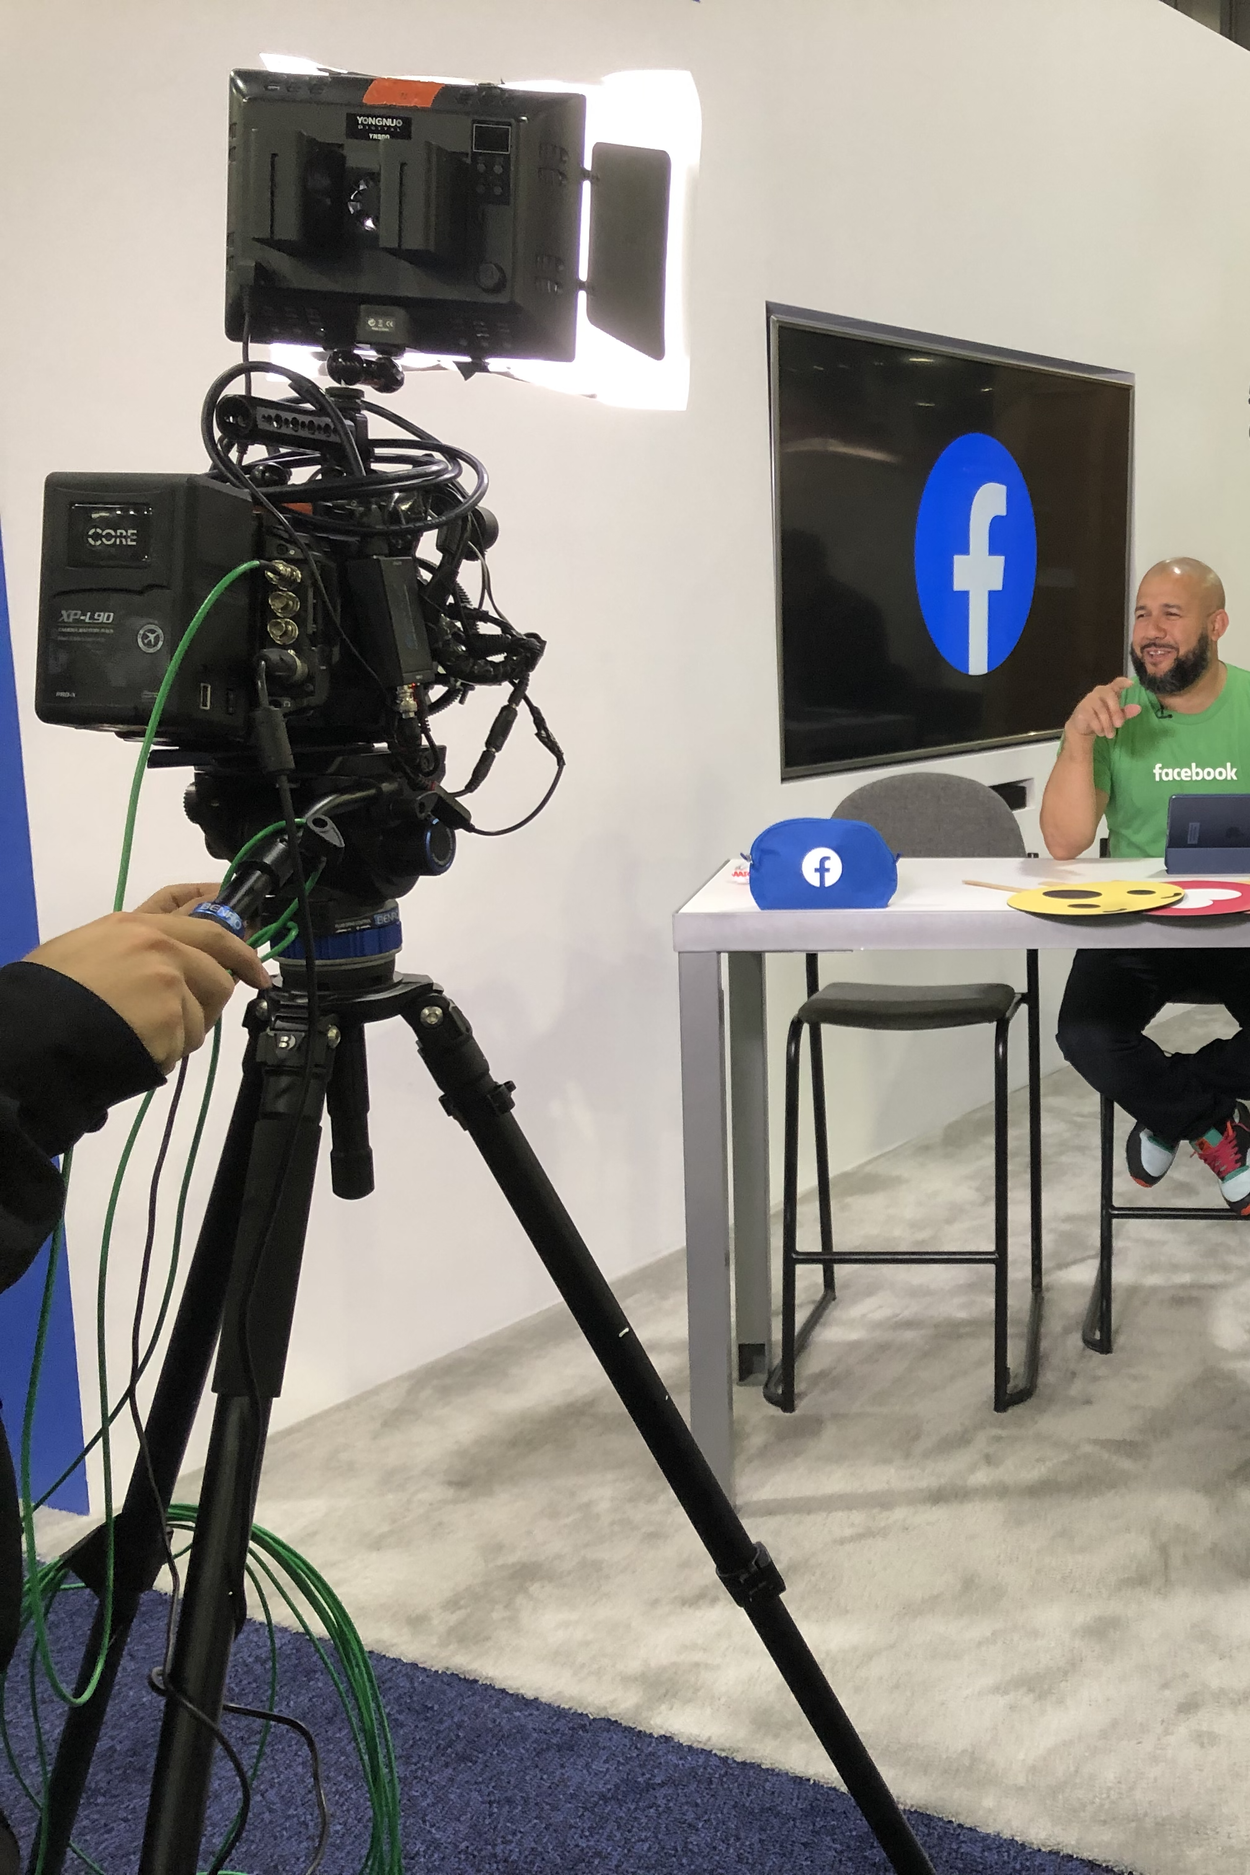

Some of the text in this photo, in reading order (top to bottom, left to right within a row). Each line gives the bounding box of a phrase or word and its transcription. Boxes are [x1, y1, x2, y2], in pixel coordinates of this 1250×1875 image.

[357, 116, 403, 127] YONGNUO
[88, 528, 137, 546] CORE
[1152, 762, 1238, 781] facebook
[201, 902, 242, 930] BENRO
